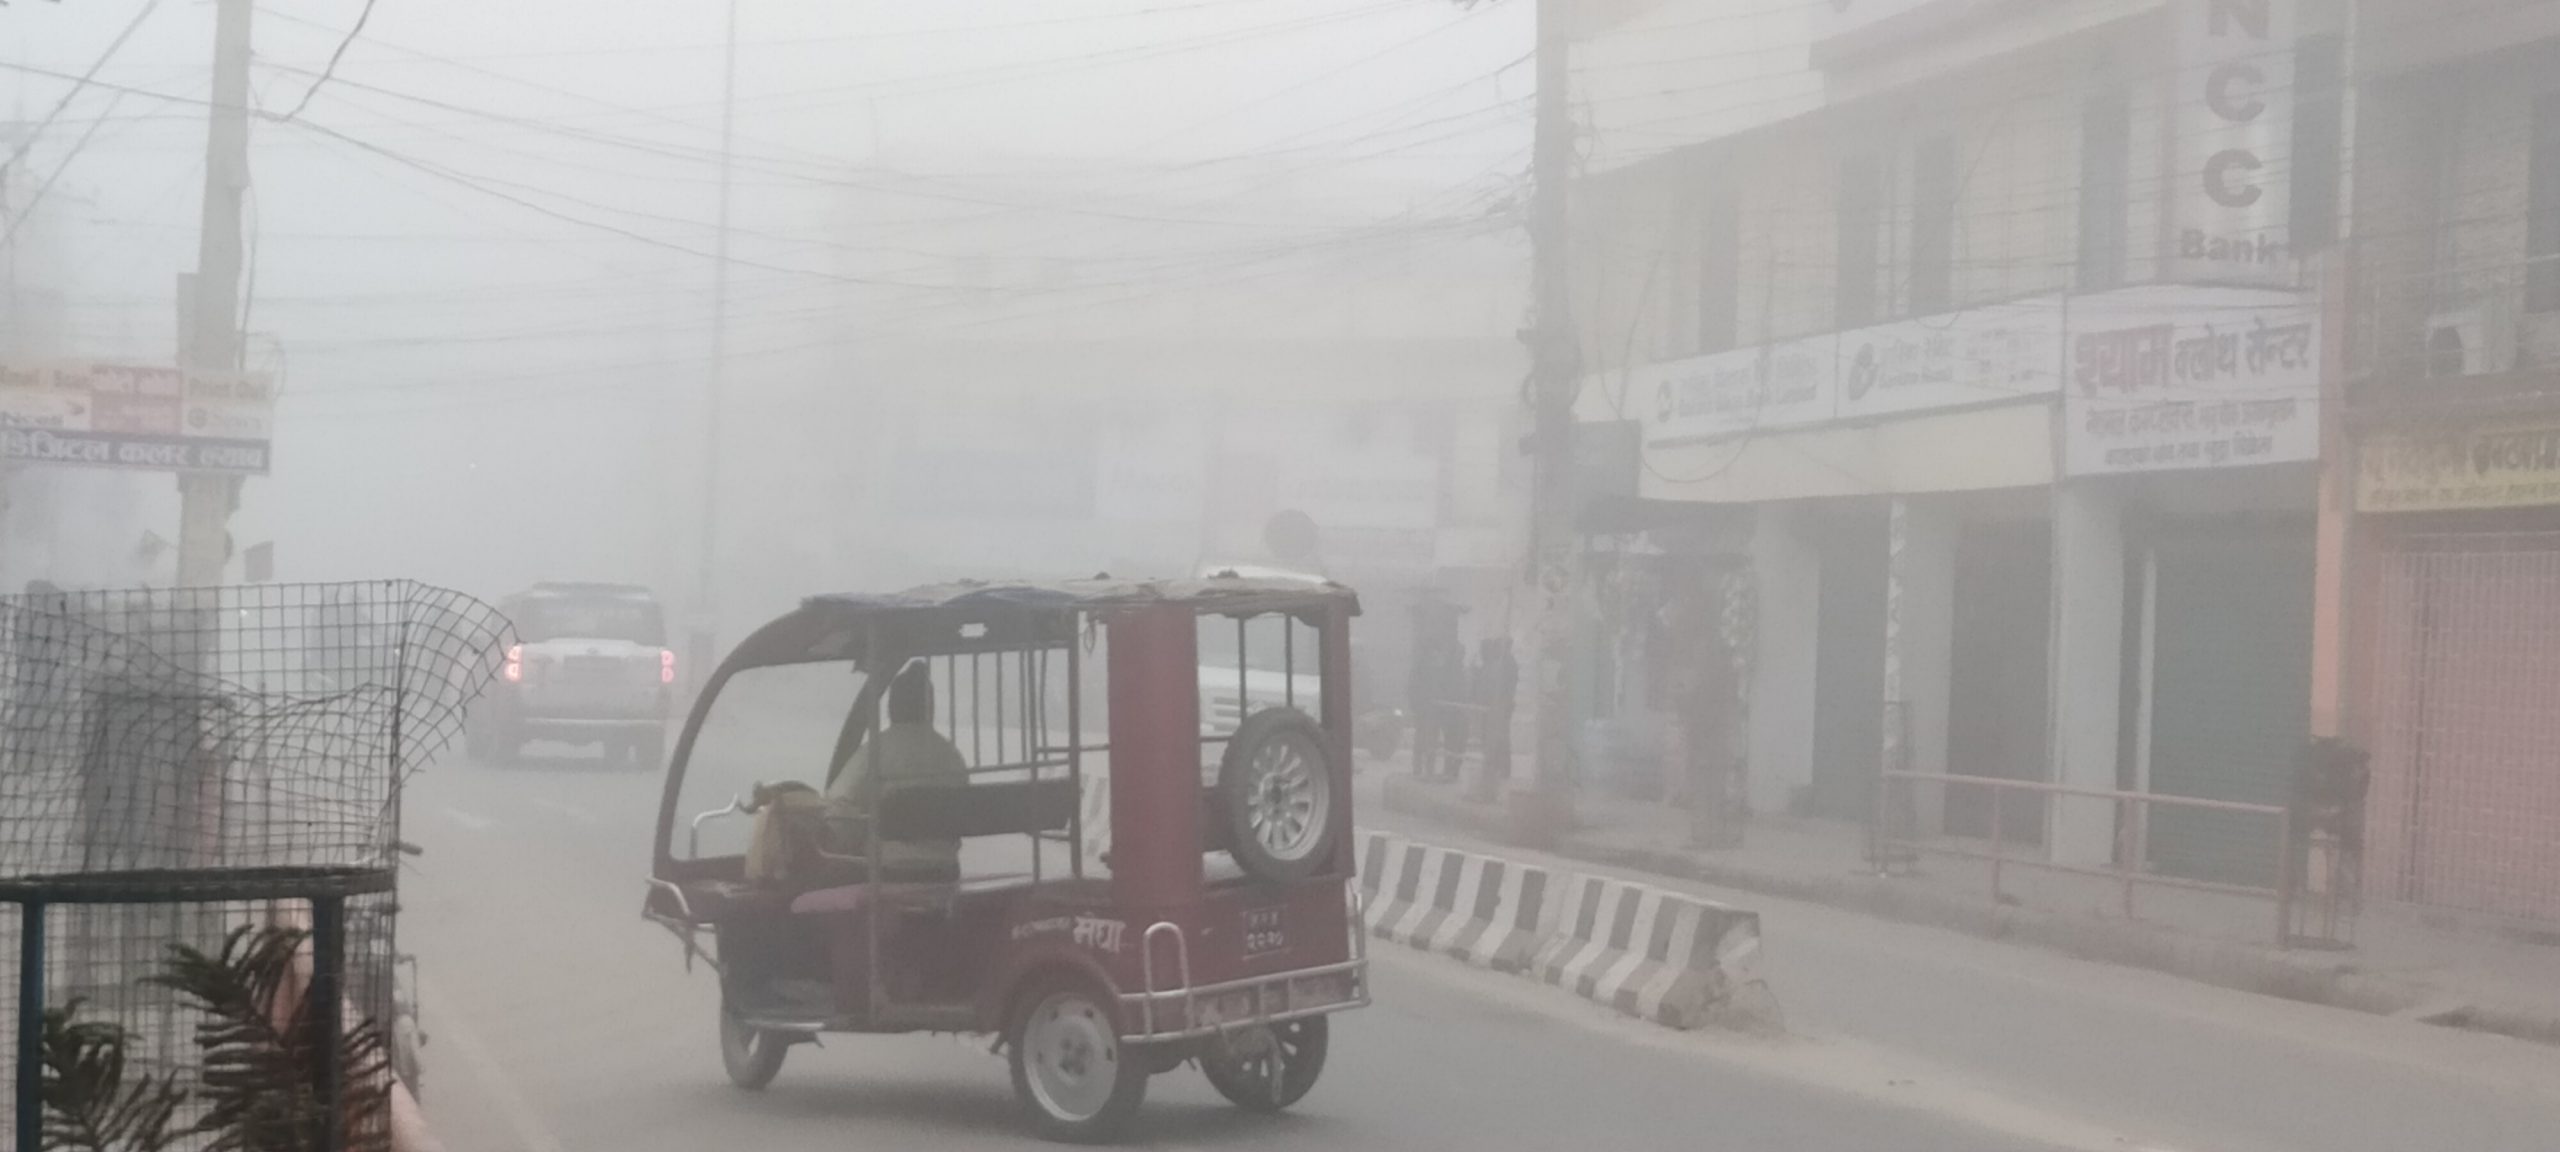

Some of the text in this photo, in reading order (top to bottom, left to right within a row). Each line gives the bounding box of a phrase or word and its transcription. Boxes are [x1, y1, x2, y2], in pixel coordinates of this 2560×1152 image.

[2203, 0, 2270, 208] NCC
[2180, 229, 2277, 264] Bank
[2074, 323, 2174, 398] श्याम
